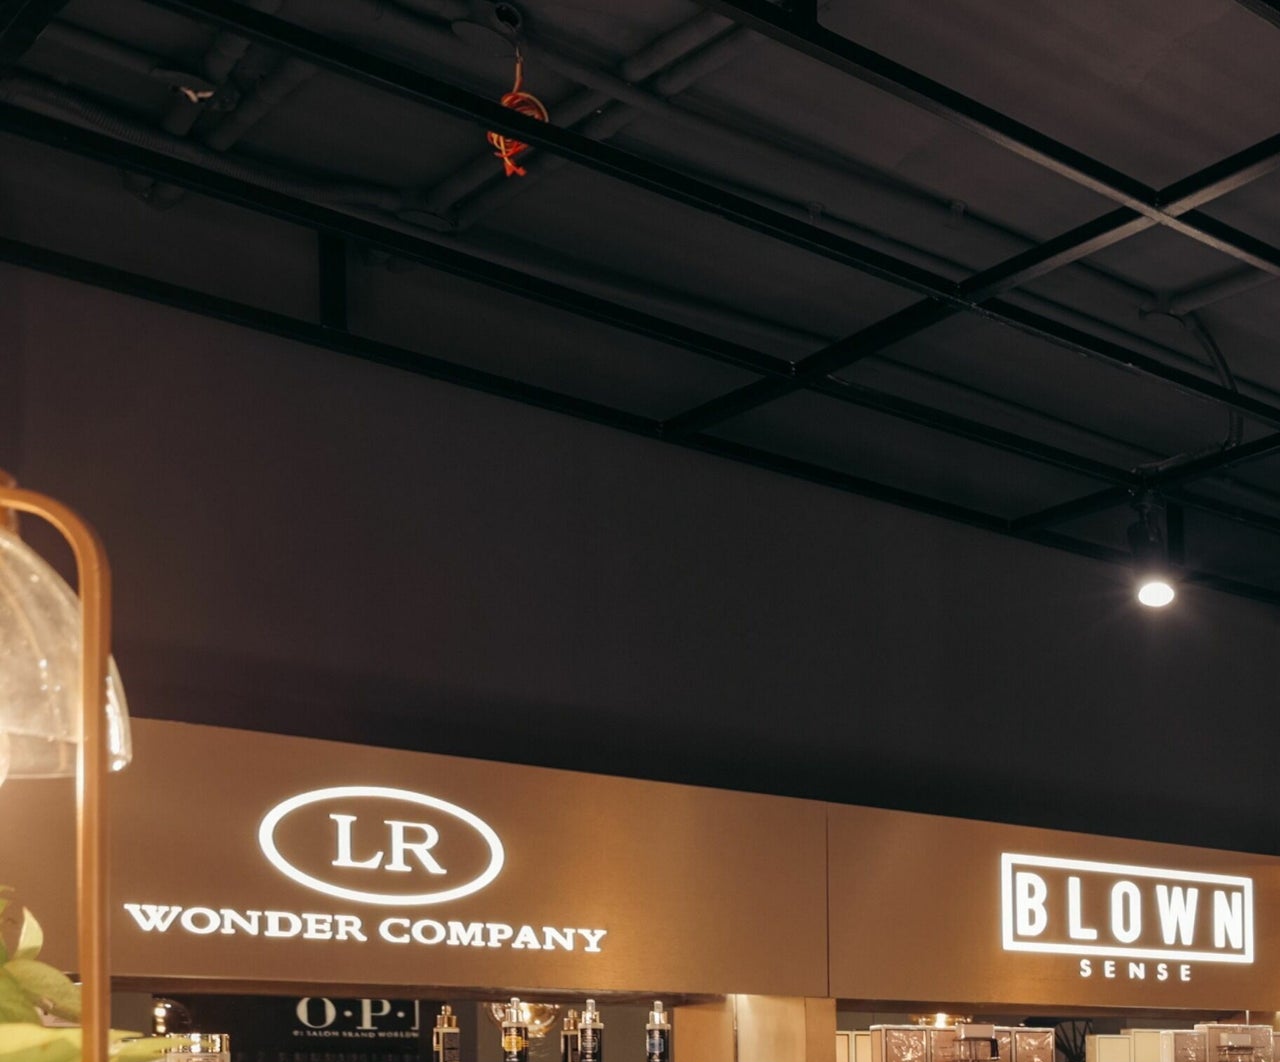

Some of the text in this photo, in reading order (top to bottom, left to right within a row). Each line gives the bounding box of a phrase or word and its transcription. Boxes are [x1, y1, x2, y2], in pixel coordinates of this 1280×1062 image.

[329, 813, 448, 875] LR
[124, 903, 607, 953] WONDER COMPANY
[1015, 871, 1243, 950] BLOWN
[1080, 958, 1191, 982] SENSE
